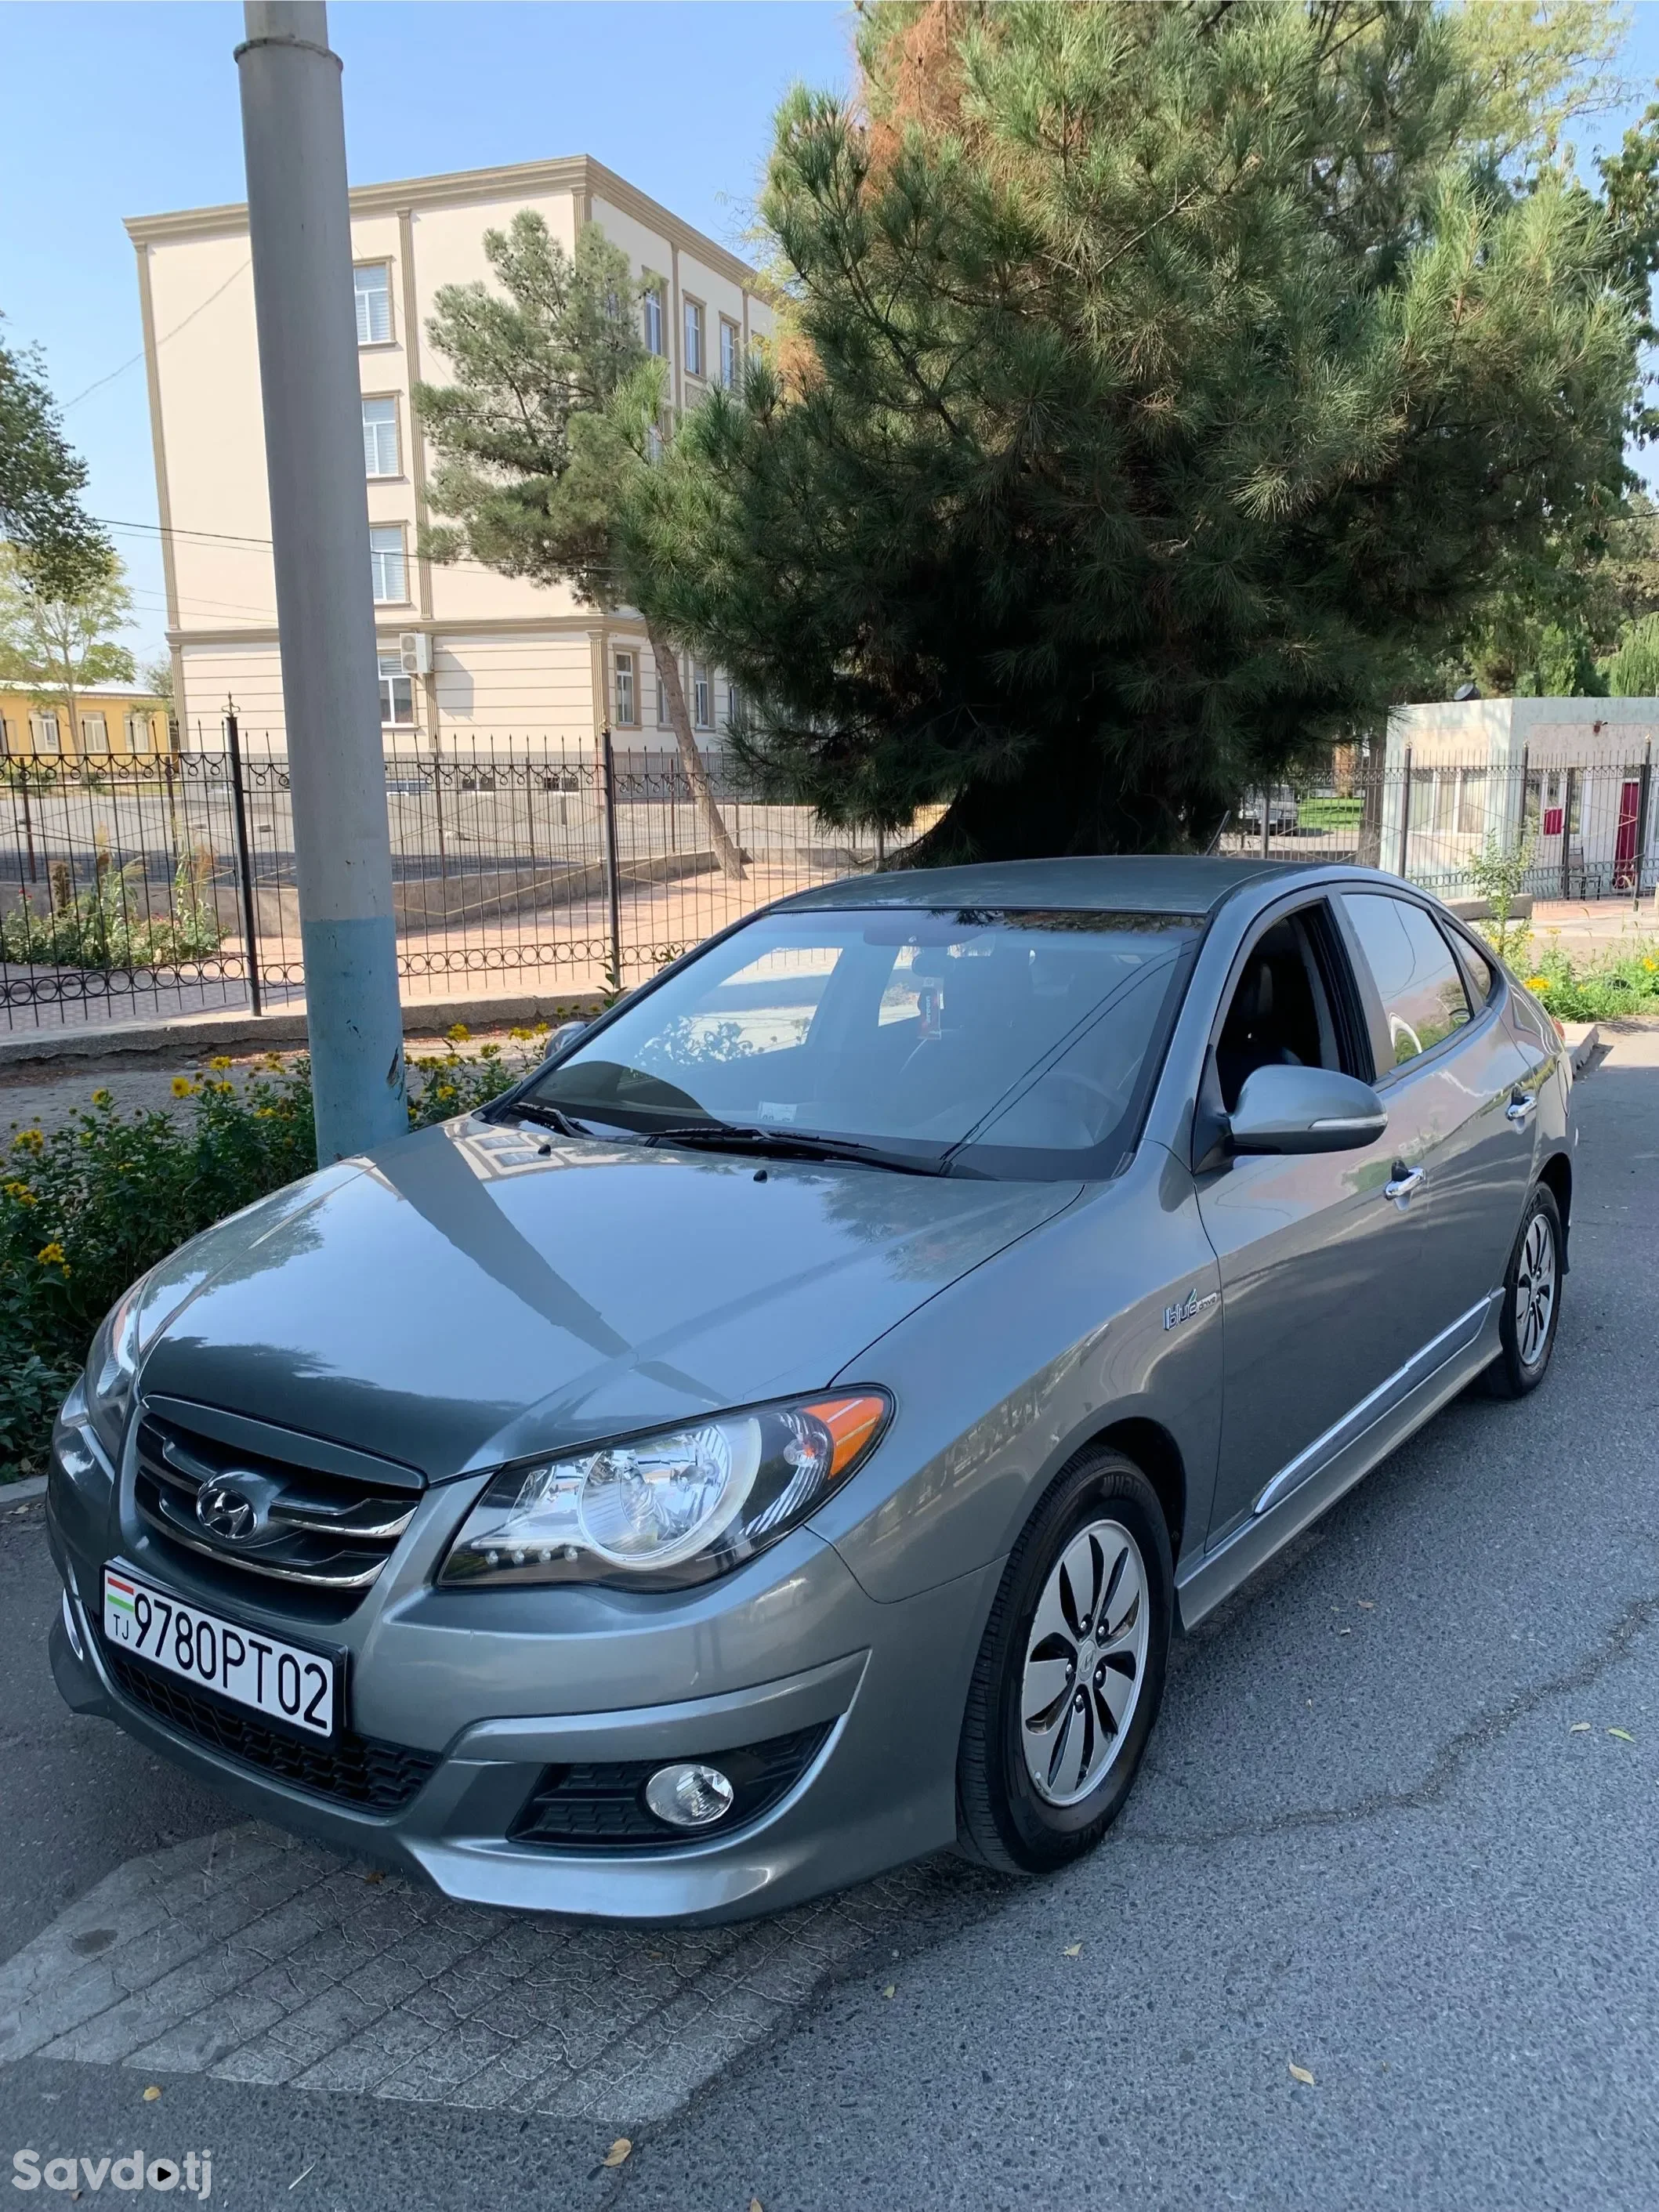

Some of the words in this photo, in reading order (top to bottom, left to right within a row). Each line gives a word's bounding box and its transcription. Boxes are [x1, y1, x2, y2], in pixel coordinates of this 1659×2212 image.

[1163, 1300, 1197, 1330] blue
[113, 1613, 129, 1640] TJ
[134, 1592, 328, 1730] 9780PT02
